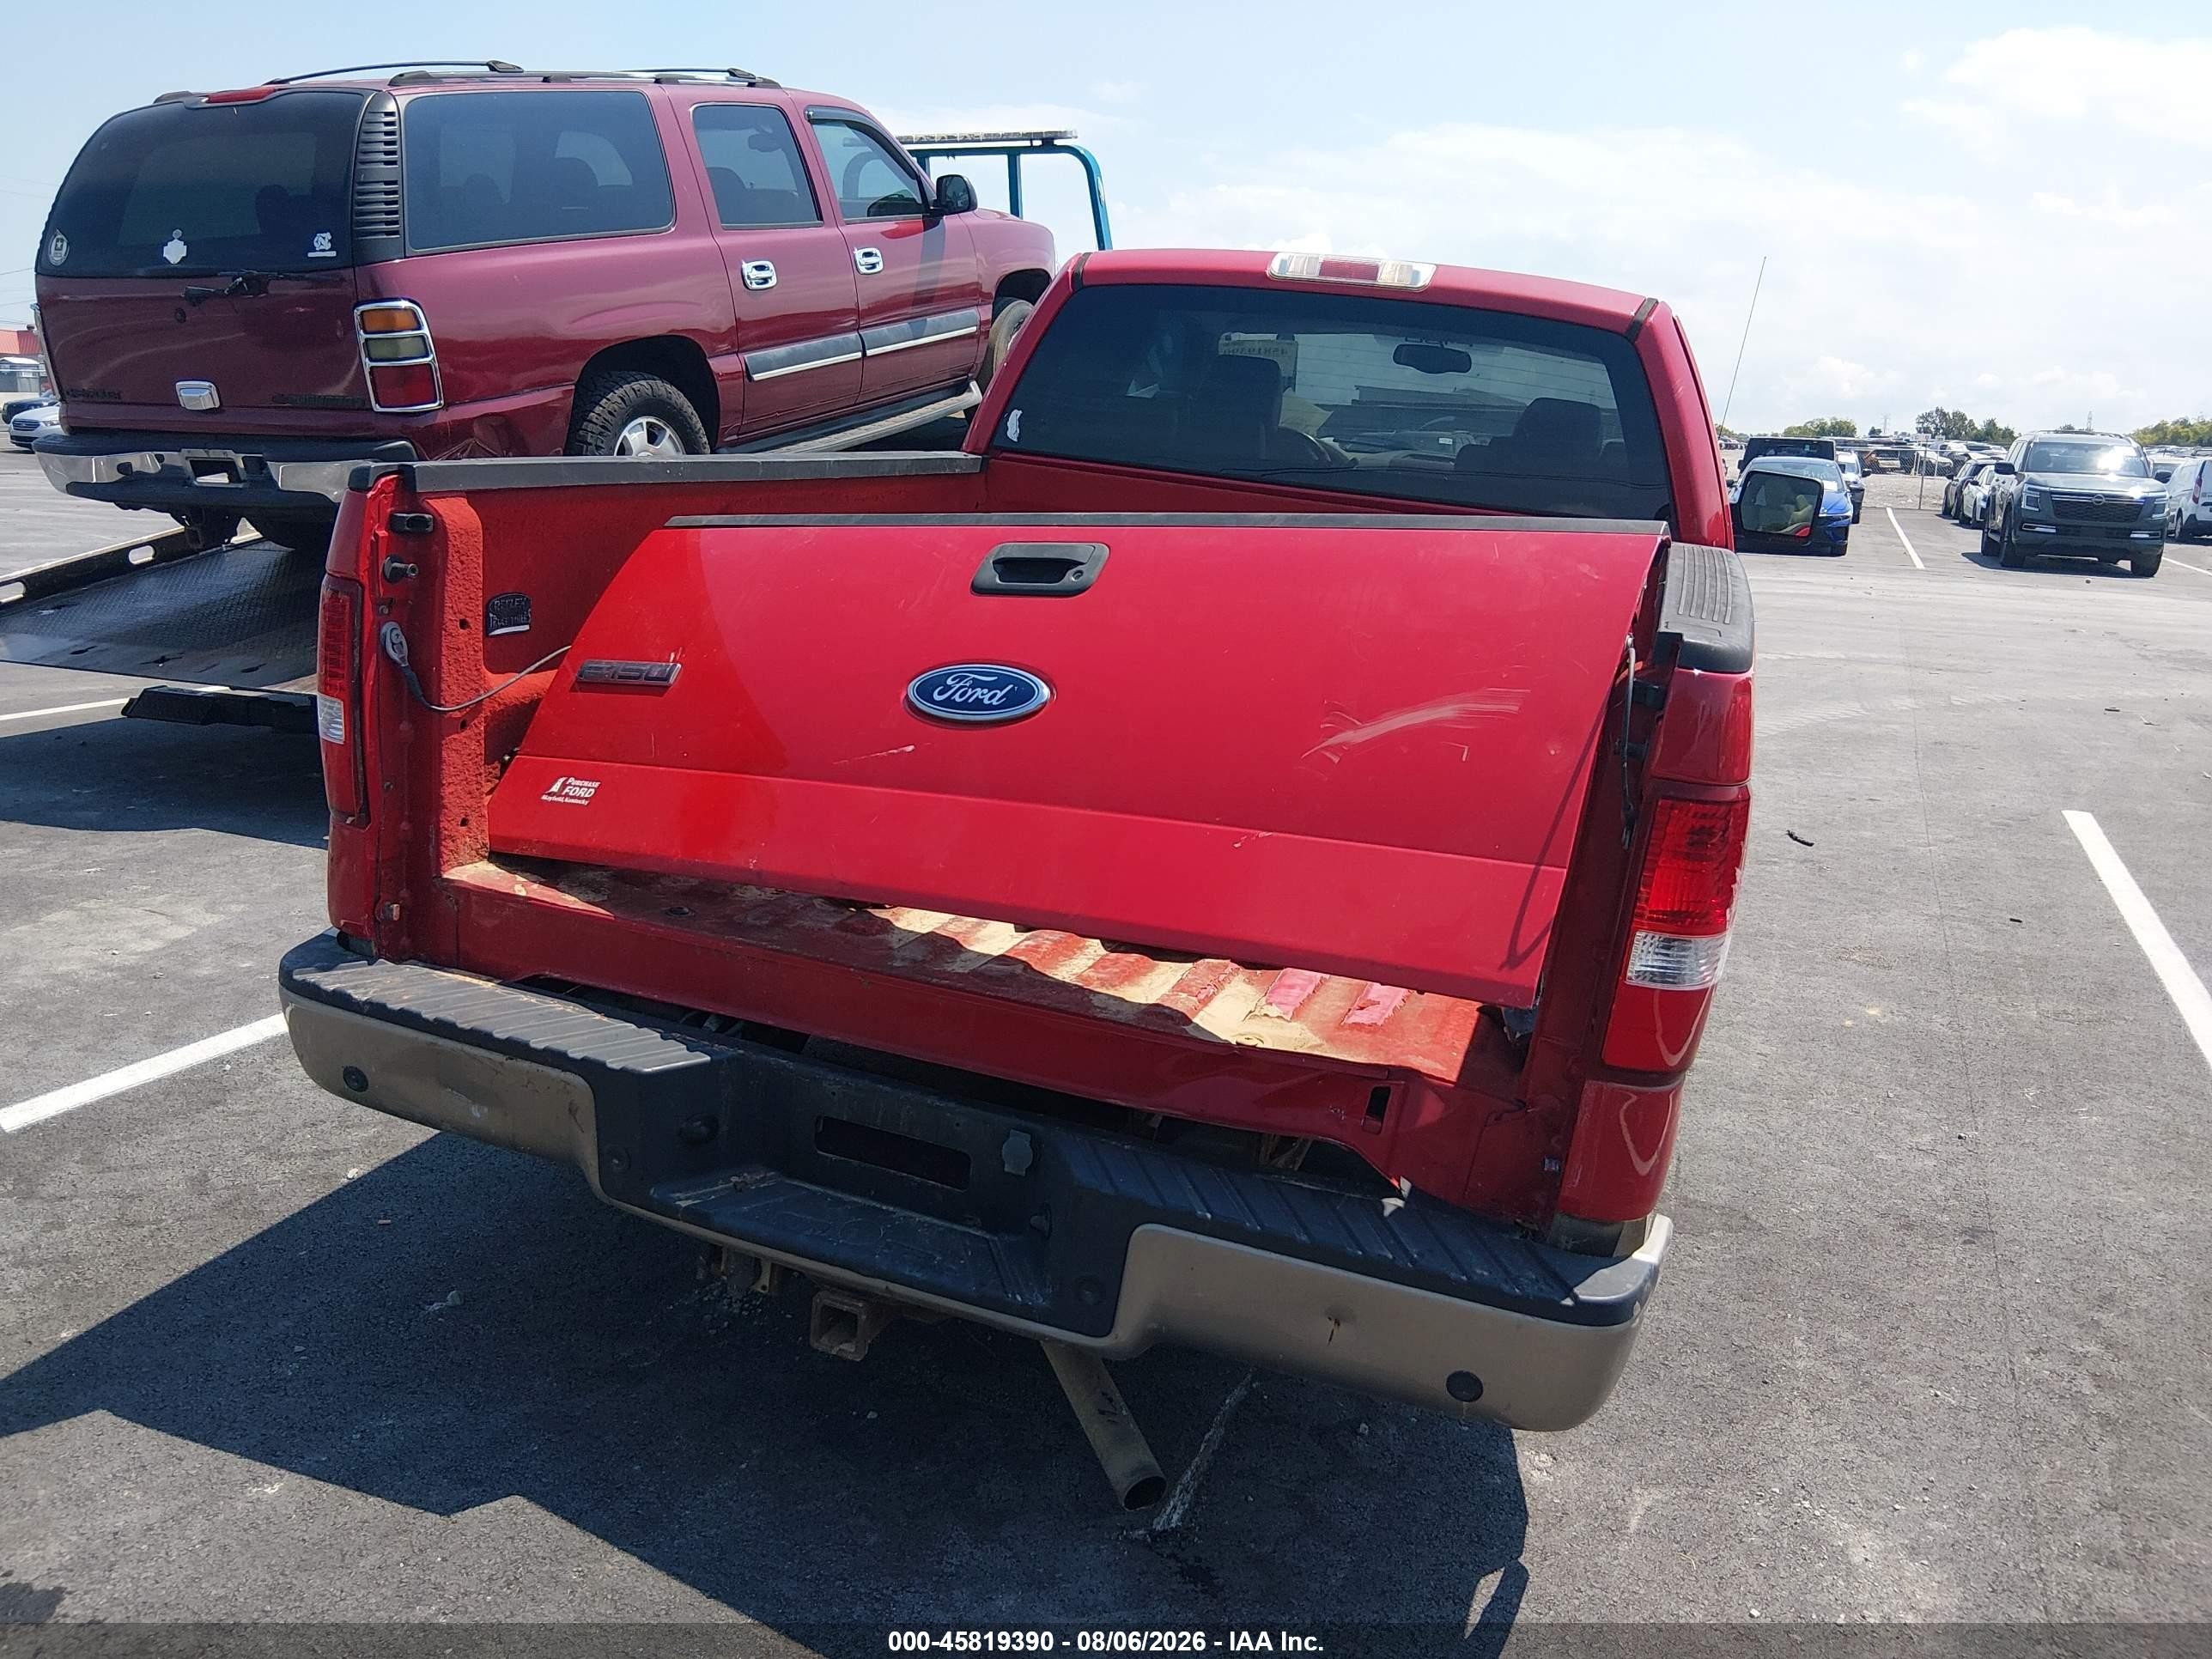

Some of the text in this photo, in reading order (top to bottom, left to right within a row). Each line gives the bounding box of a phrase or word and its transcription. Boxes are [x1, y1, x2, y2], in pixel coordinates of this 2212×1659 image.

[933, 672, 1014, 706] Ford
[562, 786, 596, 798] FORD
[564, 797, 590, 806] Kentucky
